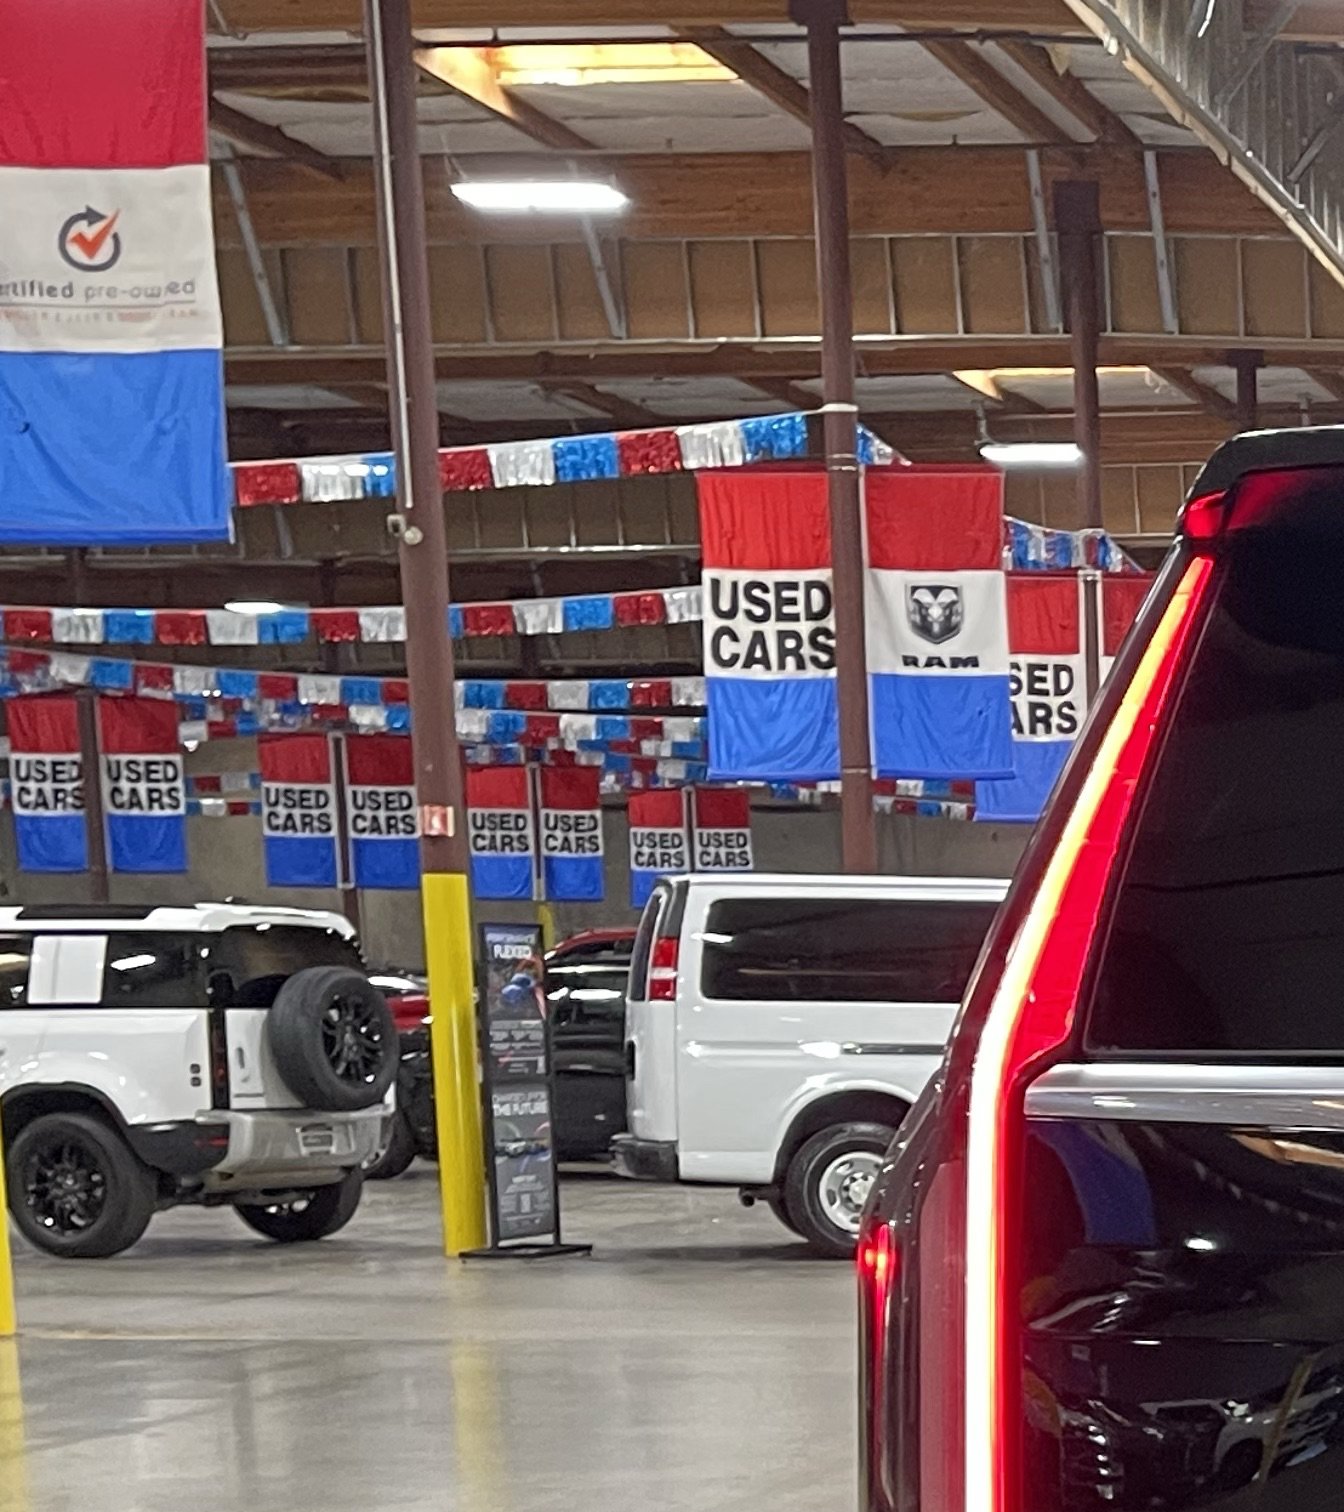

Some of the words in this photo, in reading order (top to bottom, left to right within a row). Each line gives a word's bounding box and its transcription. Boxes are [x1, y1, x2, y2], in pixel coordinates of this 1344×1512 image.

[84, 278, 196, 302] pre-owed
[710, 578, 832, 622] USED
[711, 625, 836, 671] CARS
[902, 654, 979, 669] RAM
[1010, 662, 1074, 696] SED
[14, 759, 83, 783] USED
[107, 760, 178, 783] USED
[17, 786, 85, 810] CARS
[110, 786, 181, 810] CARS
[265, 787, 330, 809] USED
[351, 789, 413, 811] USED
[267, 811, 332, 833] CARS
[351, 813, 416, 835] CARS
[472, 812, 527, 832] USED
[544, 813, 598, 833] USED
[472, 833, 530, 853] CARS
[544, 833, 600, 854] CARS
[633, 831, 683, 850] USED
[699, 831, 748, 849] USED
[634, 851, 685, 868] CARS
[700, 850, 750, 868] CARS
